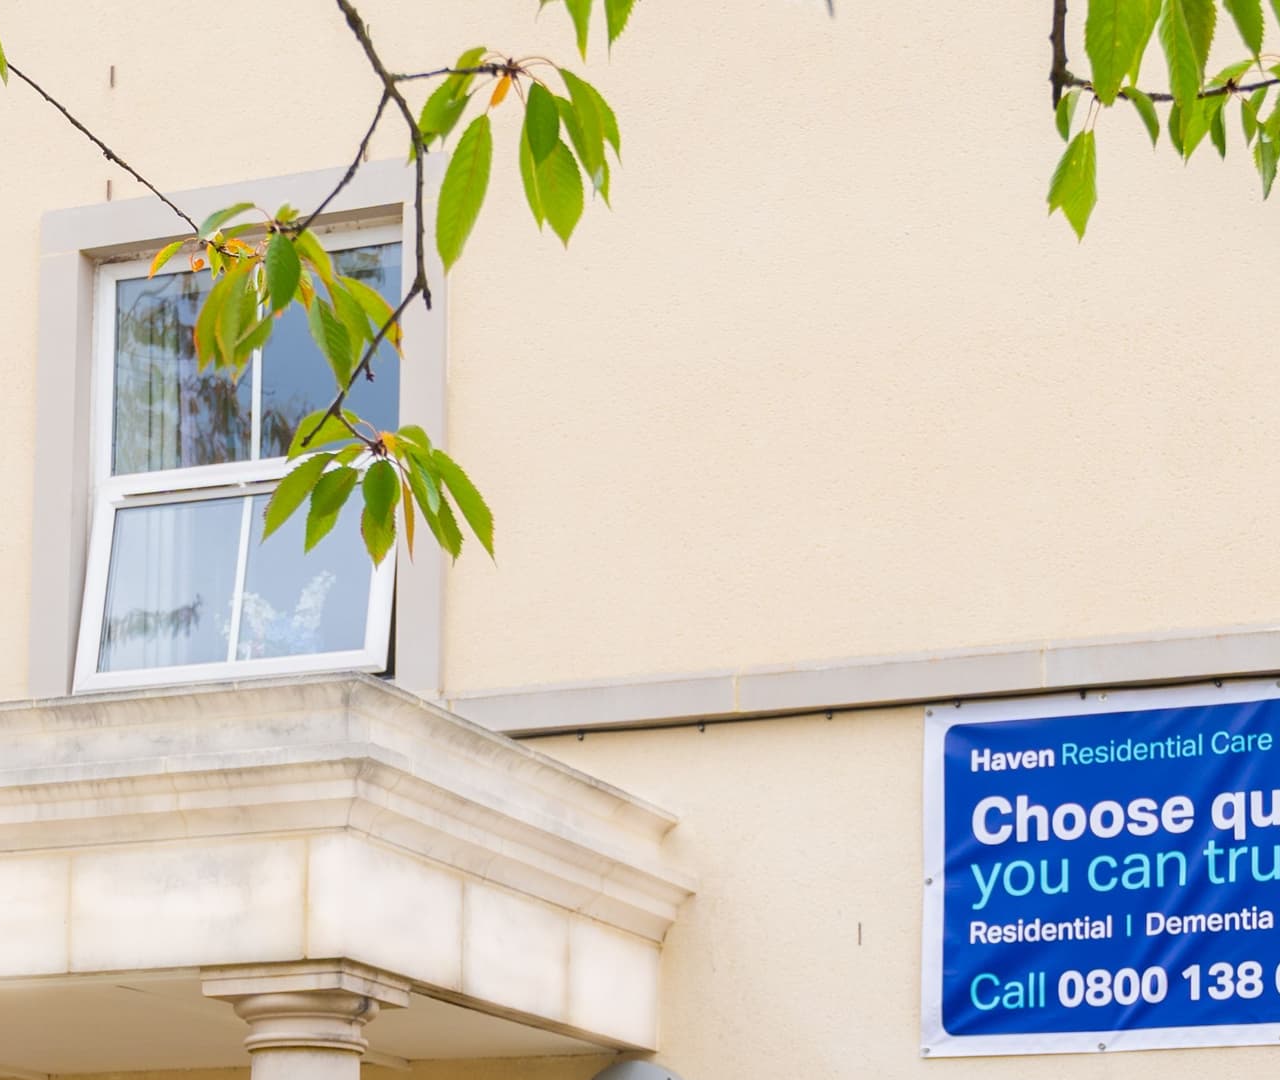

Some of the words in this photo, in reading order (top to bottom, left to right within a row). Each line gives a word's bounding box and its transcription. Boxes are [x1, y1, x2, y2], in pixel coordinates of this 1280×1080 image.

[970, 748, 1055, 773] Haven
[1061, 734, 1203, 766] Residential
[1210, 731, 1273, 756] Care
[971, 794, 1195, 846] Choose
[970, 857, 1070, 911] you
[1087, 849, 1187, 893] can
[969, 914, 1113, 945] Residential
[1145, 906, 1275, 938] Dementia
[970, 972, 1046, 1011] Call
[1057, 965, 1169, 1009] 0800
[1181, 960, 1265, 1002] 138
